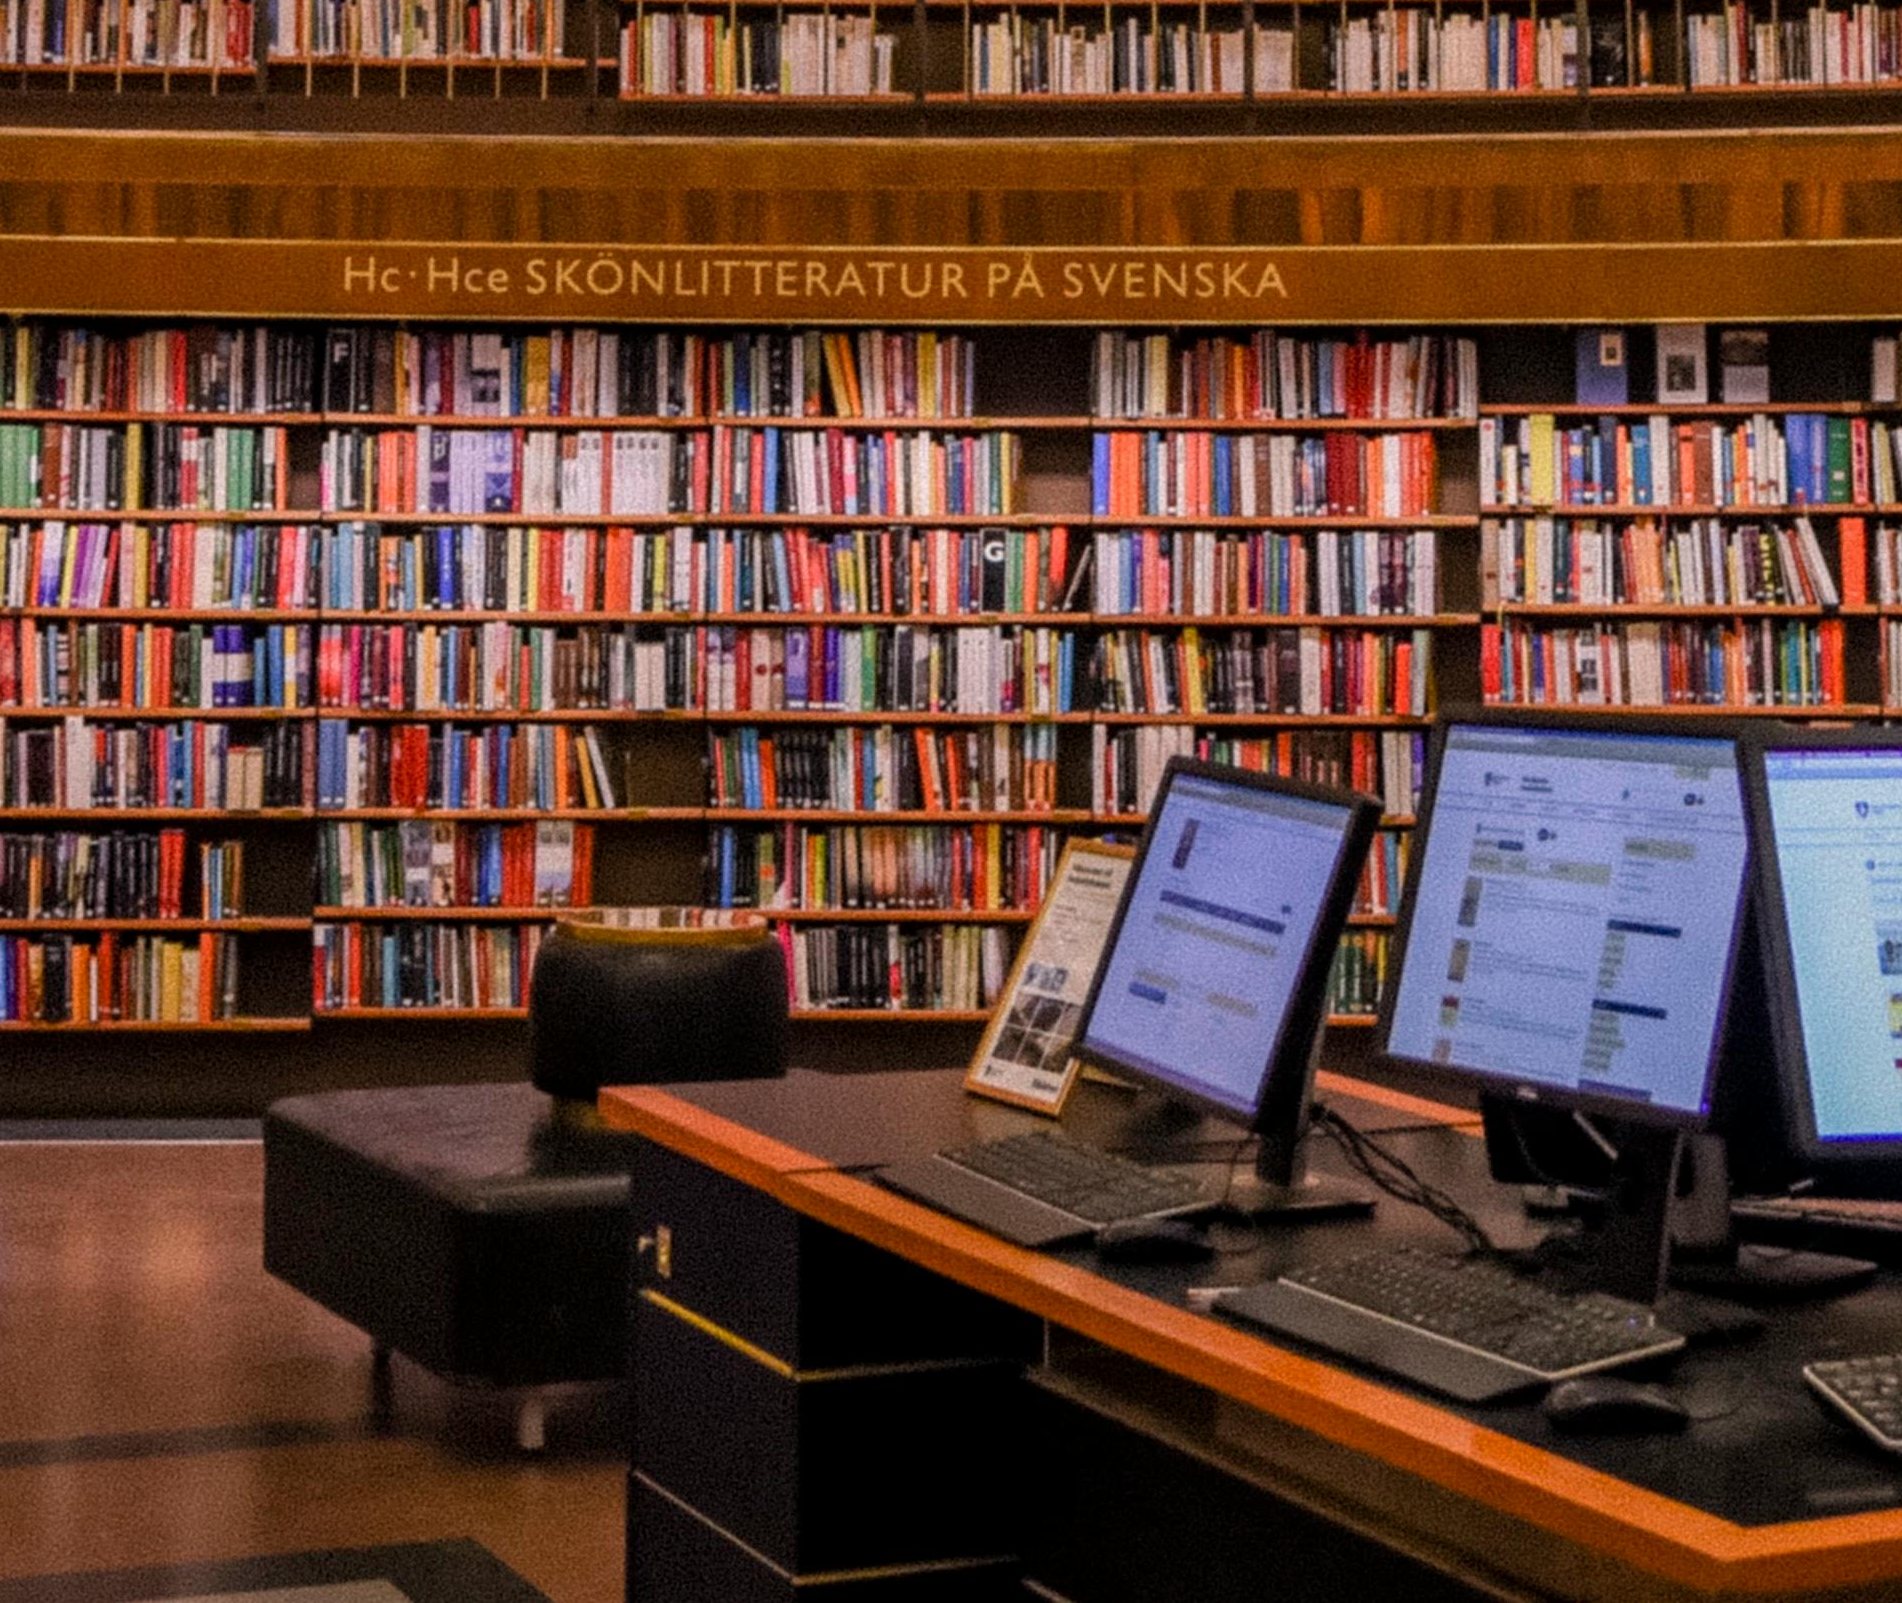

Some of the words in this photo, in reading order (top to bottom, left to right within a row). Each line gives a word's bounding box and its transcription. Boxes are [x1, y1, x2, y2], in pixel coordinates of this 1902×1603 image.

[525, 252, 968, 297] SKÖNLITTERATUR
[987, 253, 1045, 297] PÅ
[1063, 261, 1288, 298] SVENSKA
[983, 540, 1005, 563] G
